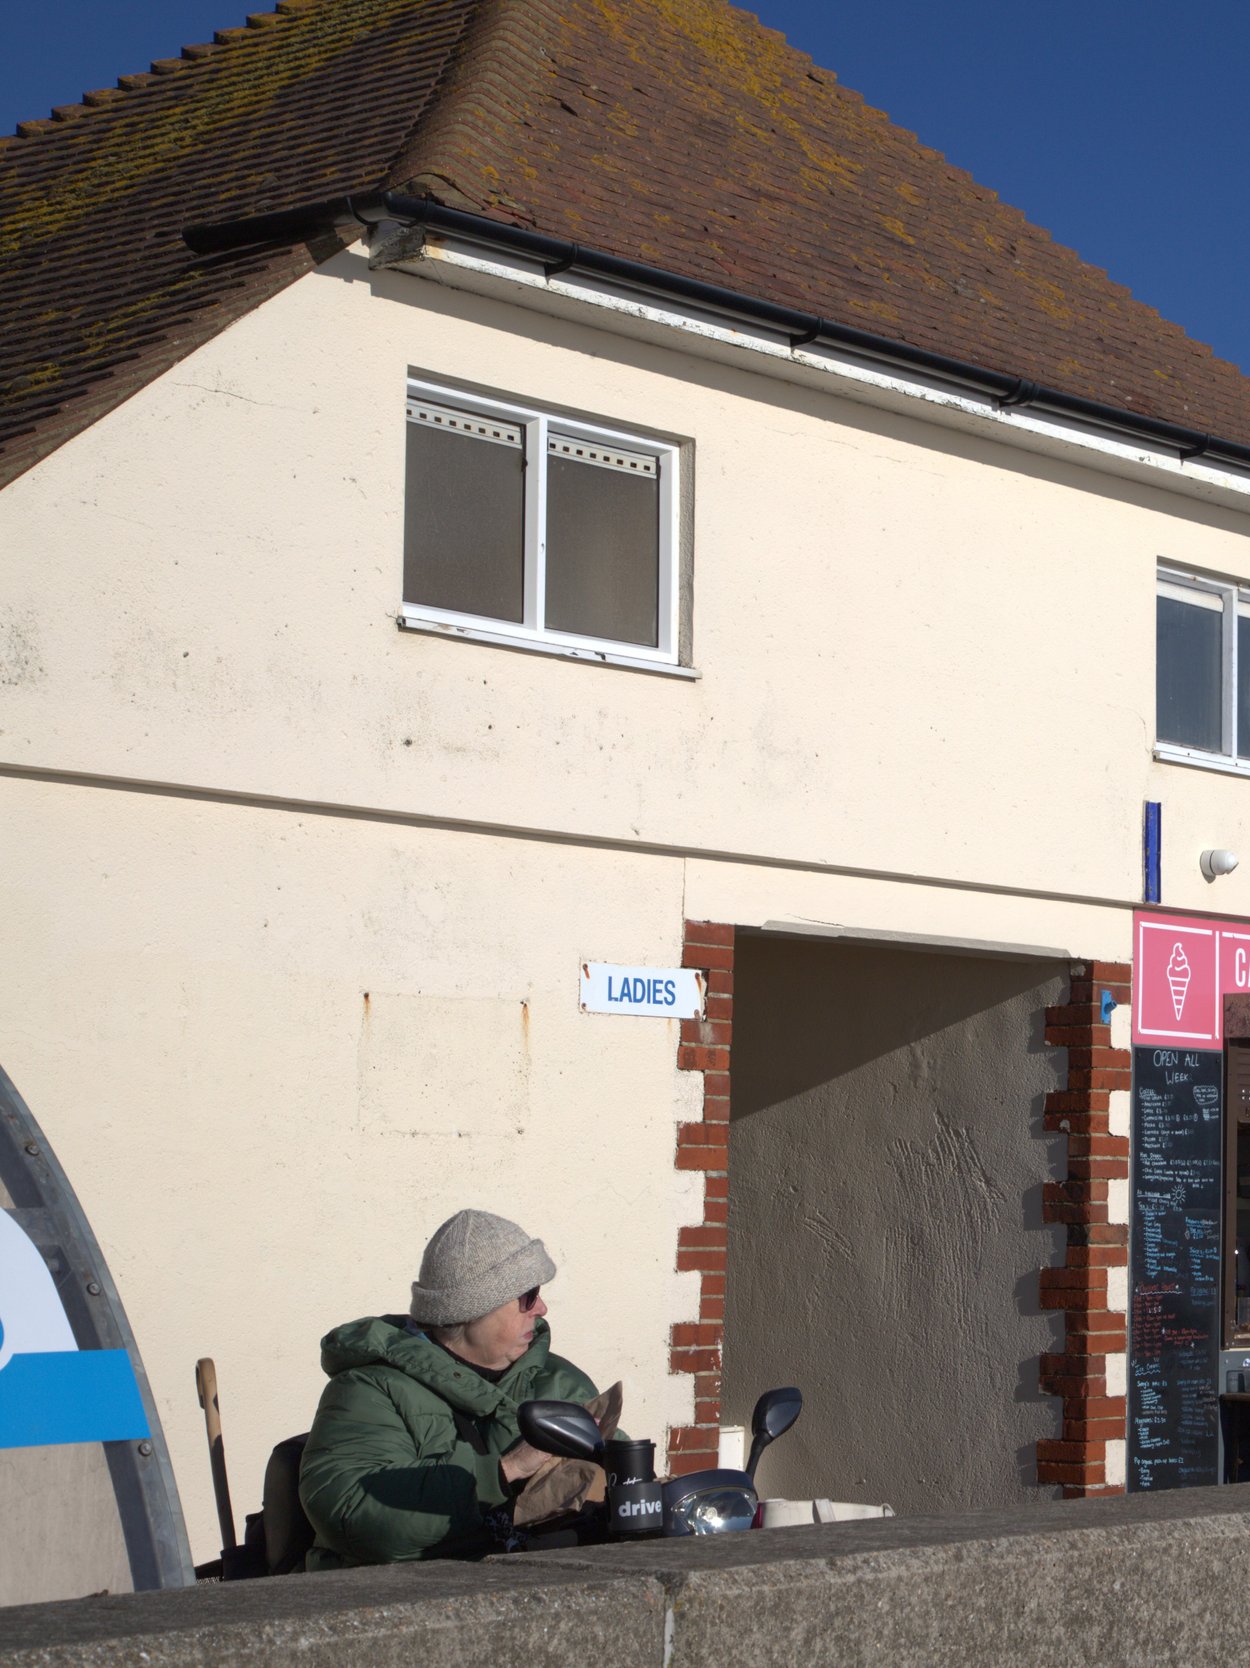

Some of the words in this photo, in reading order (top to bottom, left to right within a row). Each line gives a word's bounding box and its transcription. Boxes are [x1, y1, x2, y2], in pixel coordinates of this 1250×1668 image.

[608, 976, 676, 1006] LADIES
[1153, 1050, 1178, 1067] OPEN
[1184, 1053, 1200, 1067] ALL
[1165, 1071, 1189, 1085] WEEK
[618, 1498, 662, 1517] drive
